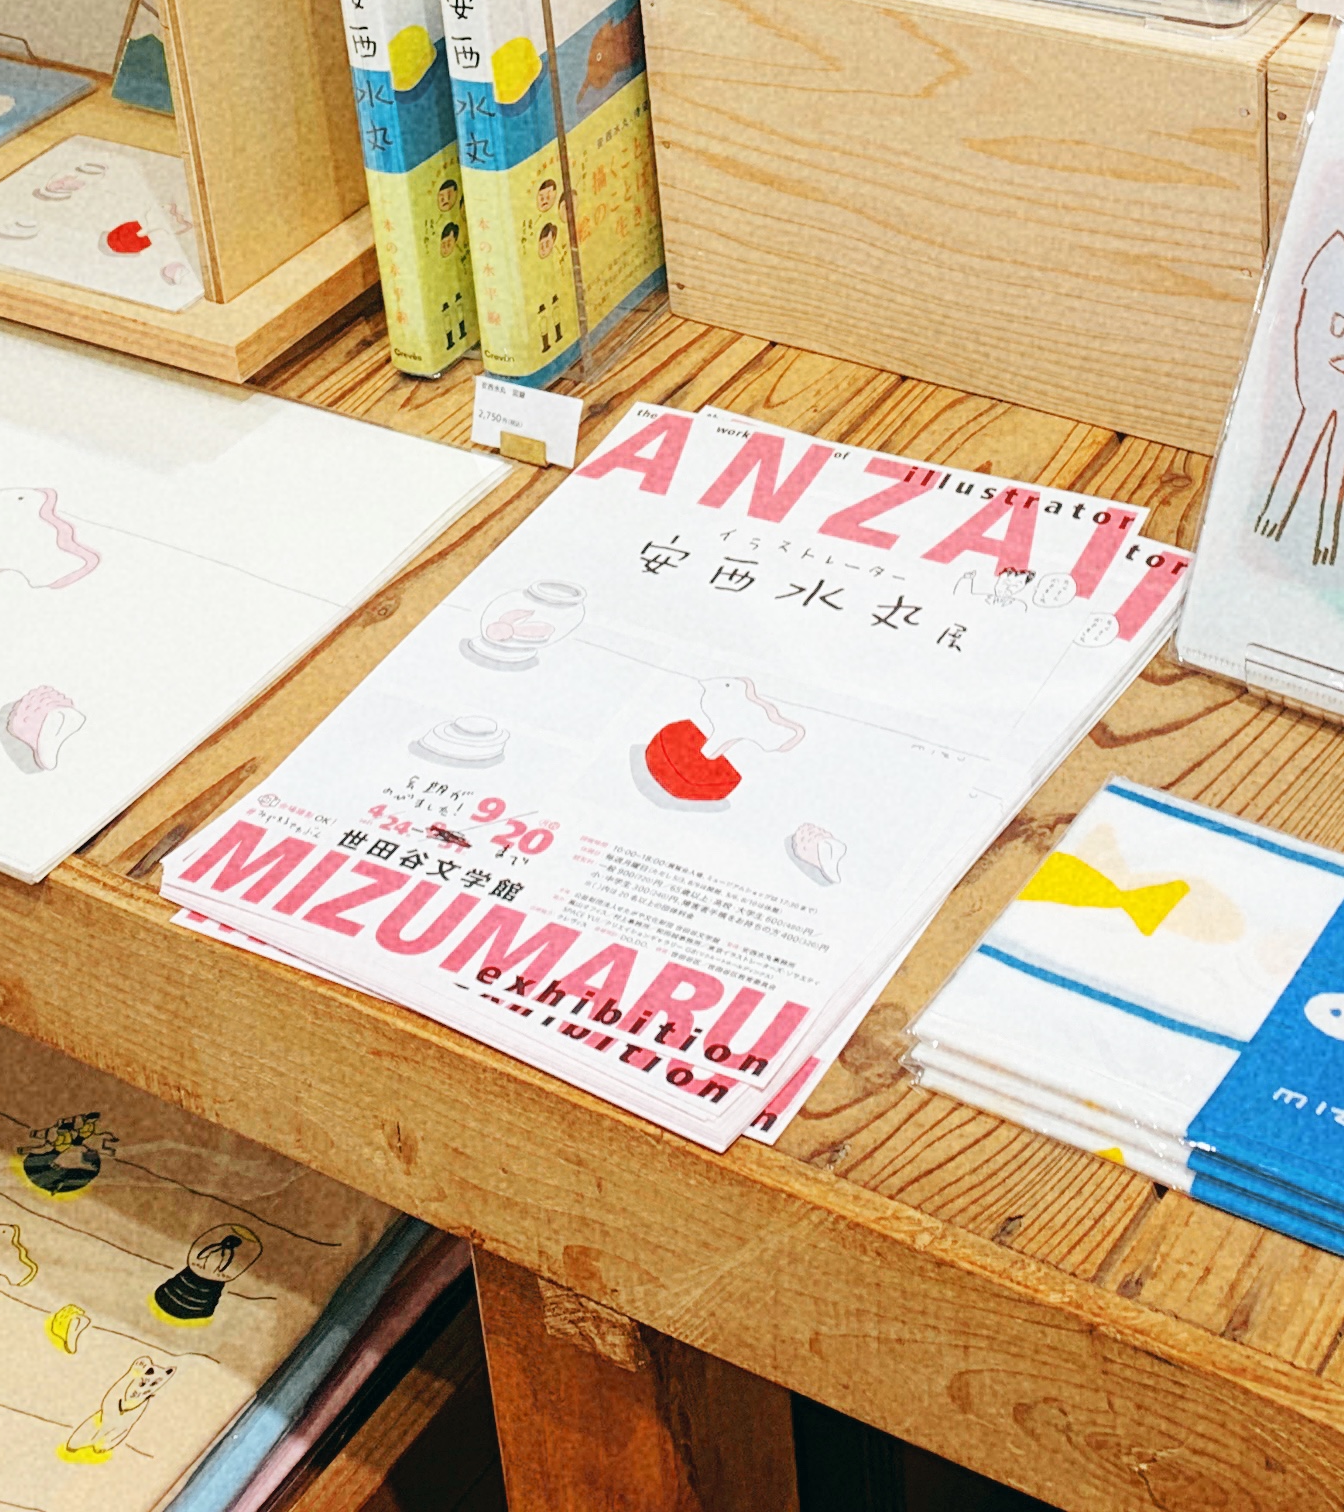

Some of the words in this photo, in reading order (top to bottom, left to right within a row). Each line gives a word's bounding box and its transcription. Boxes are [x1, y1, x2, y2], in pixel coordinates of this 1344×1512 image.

[573, 411, 1140, 601] ANZAI
[635, 407, 659, 421] the
[714, 424, 752, 440] work
[832, 448, 851, 462] of
[902, 463, 1135, 530] illustrator
[719, 528, 906, 582] イラストレーター
[336, 828, 525, 904] 世田谷文学館
[178, 819, 811, 1071] MIZUMARU
[475, 962, 770, 1078] exhibition
